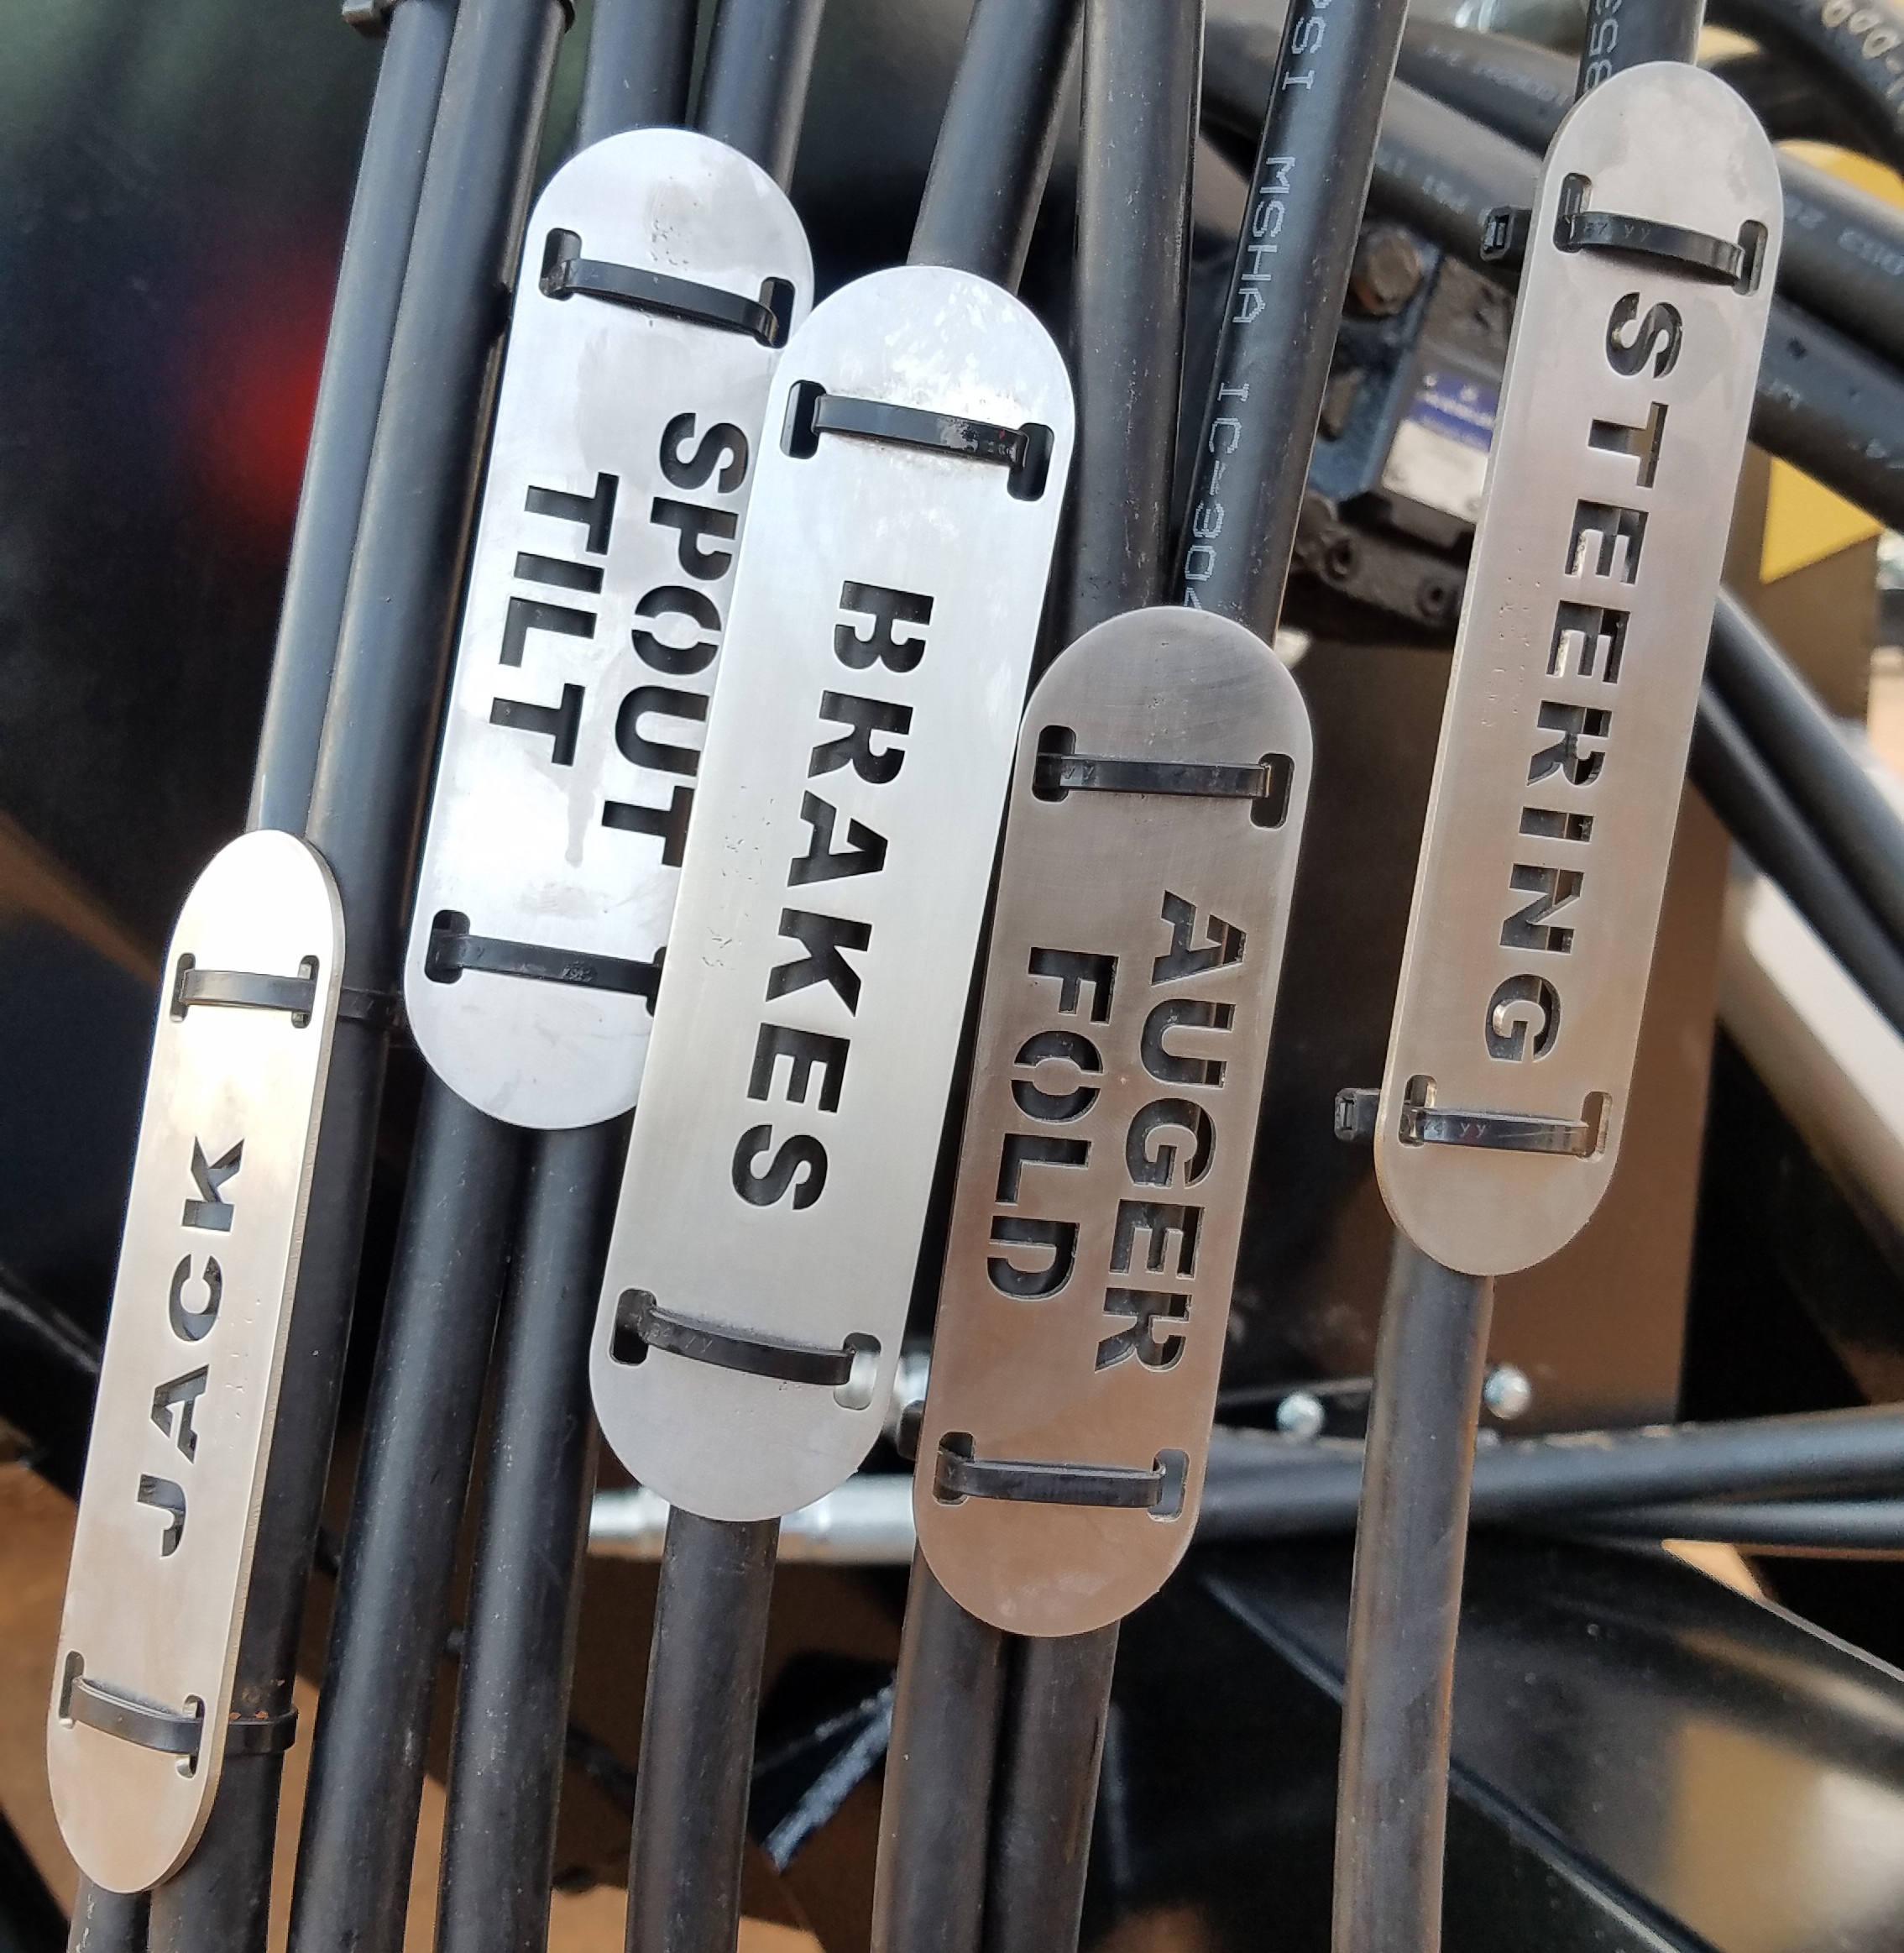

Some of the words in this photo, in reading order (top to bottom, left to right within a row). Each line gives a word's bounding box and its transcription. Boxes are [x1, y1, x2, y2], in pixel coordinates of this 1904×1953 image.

[1232, 155, 1295, 324] MSHA
[1281, 0, 1332, 90] SI
[489, 471, 620, 767] TILT
[601, 412, 749, 867] SPOUT
[1484, 291, 1683, 1064] STEERING
[730, 579, 934, 1212] BRAKES
[986, 946, 1119, 1301] FOLD
[1095, 889, 1247, 1374] AUGER
[137, 1134, 245, 1559] JACK
